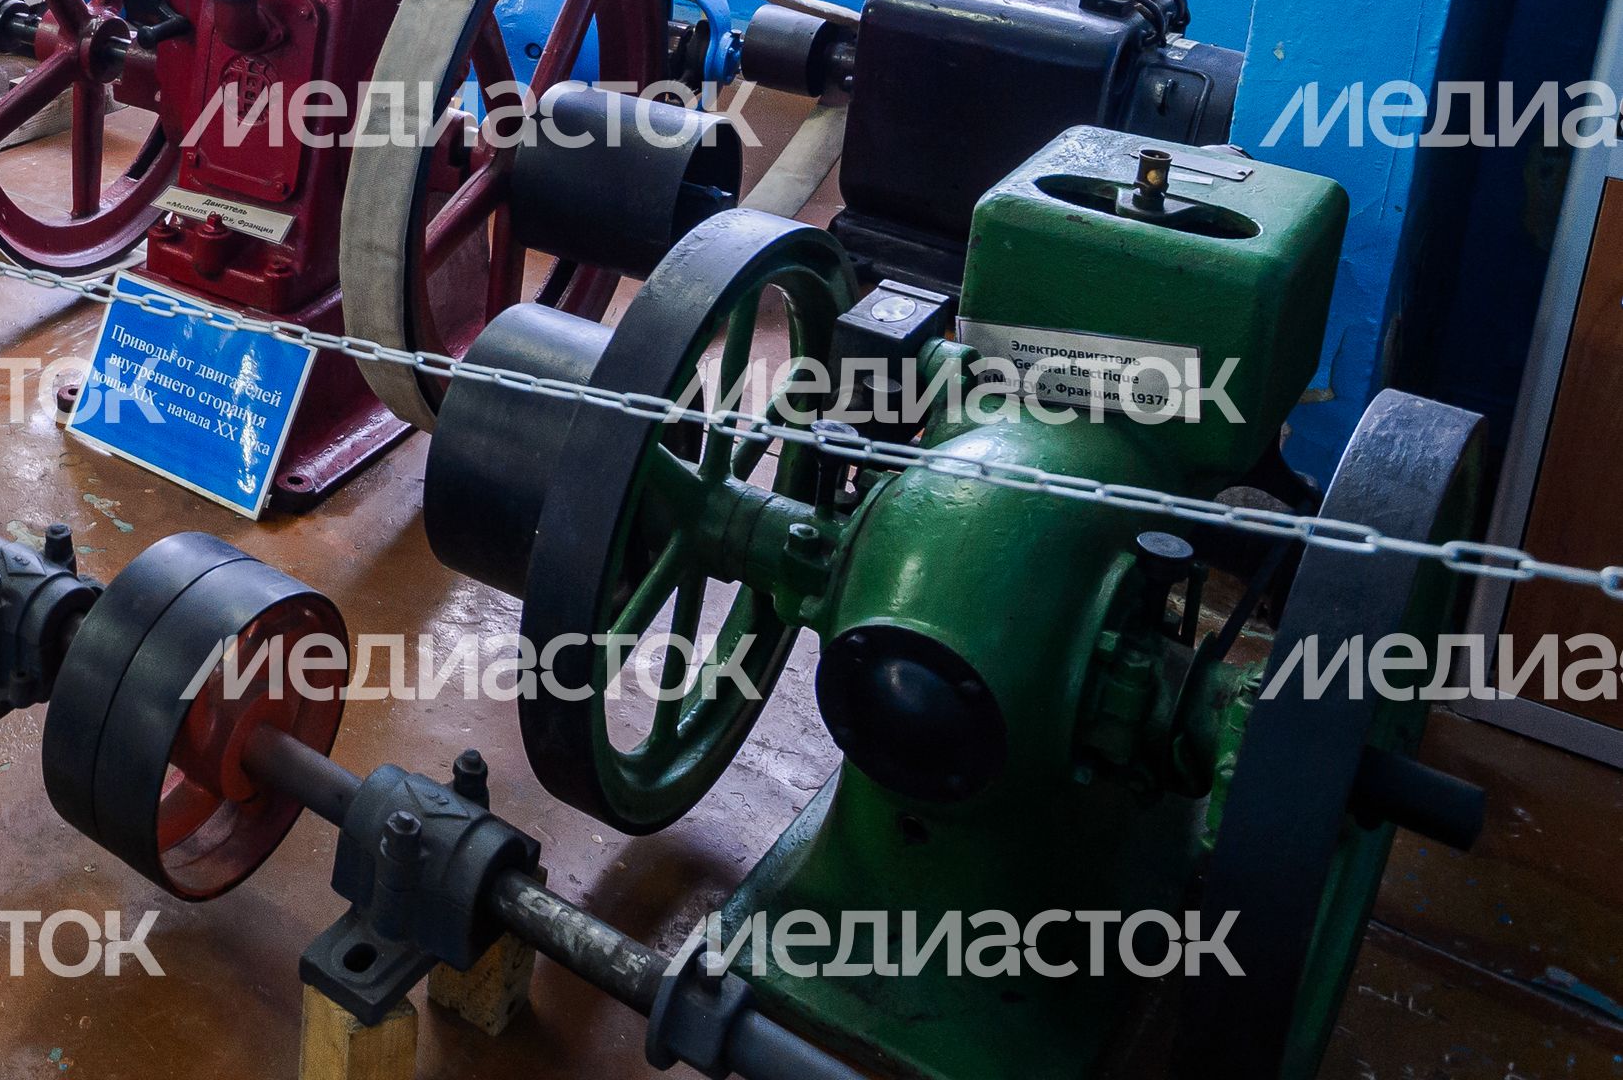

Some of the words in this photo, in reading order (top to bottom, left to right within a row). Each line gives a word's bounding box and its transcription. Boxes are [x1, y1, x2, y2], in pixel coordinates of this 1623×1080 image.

[202, 198, 248, 215] Двигатель
[177, 355, 195, 371] от
[1011, 340, 1141, 366] Электродвигатель
[92, 370, 127, 395] конца
[167, 403, 211, 430] начала
